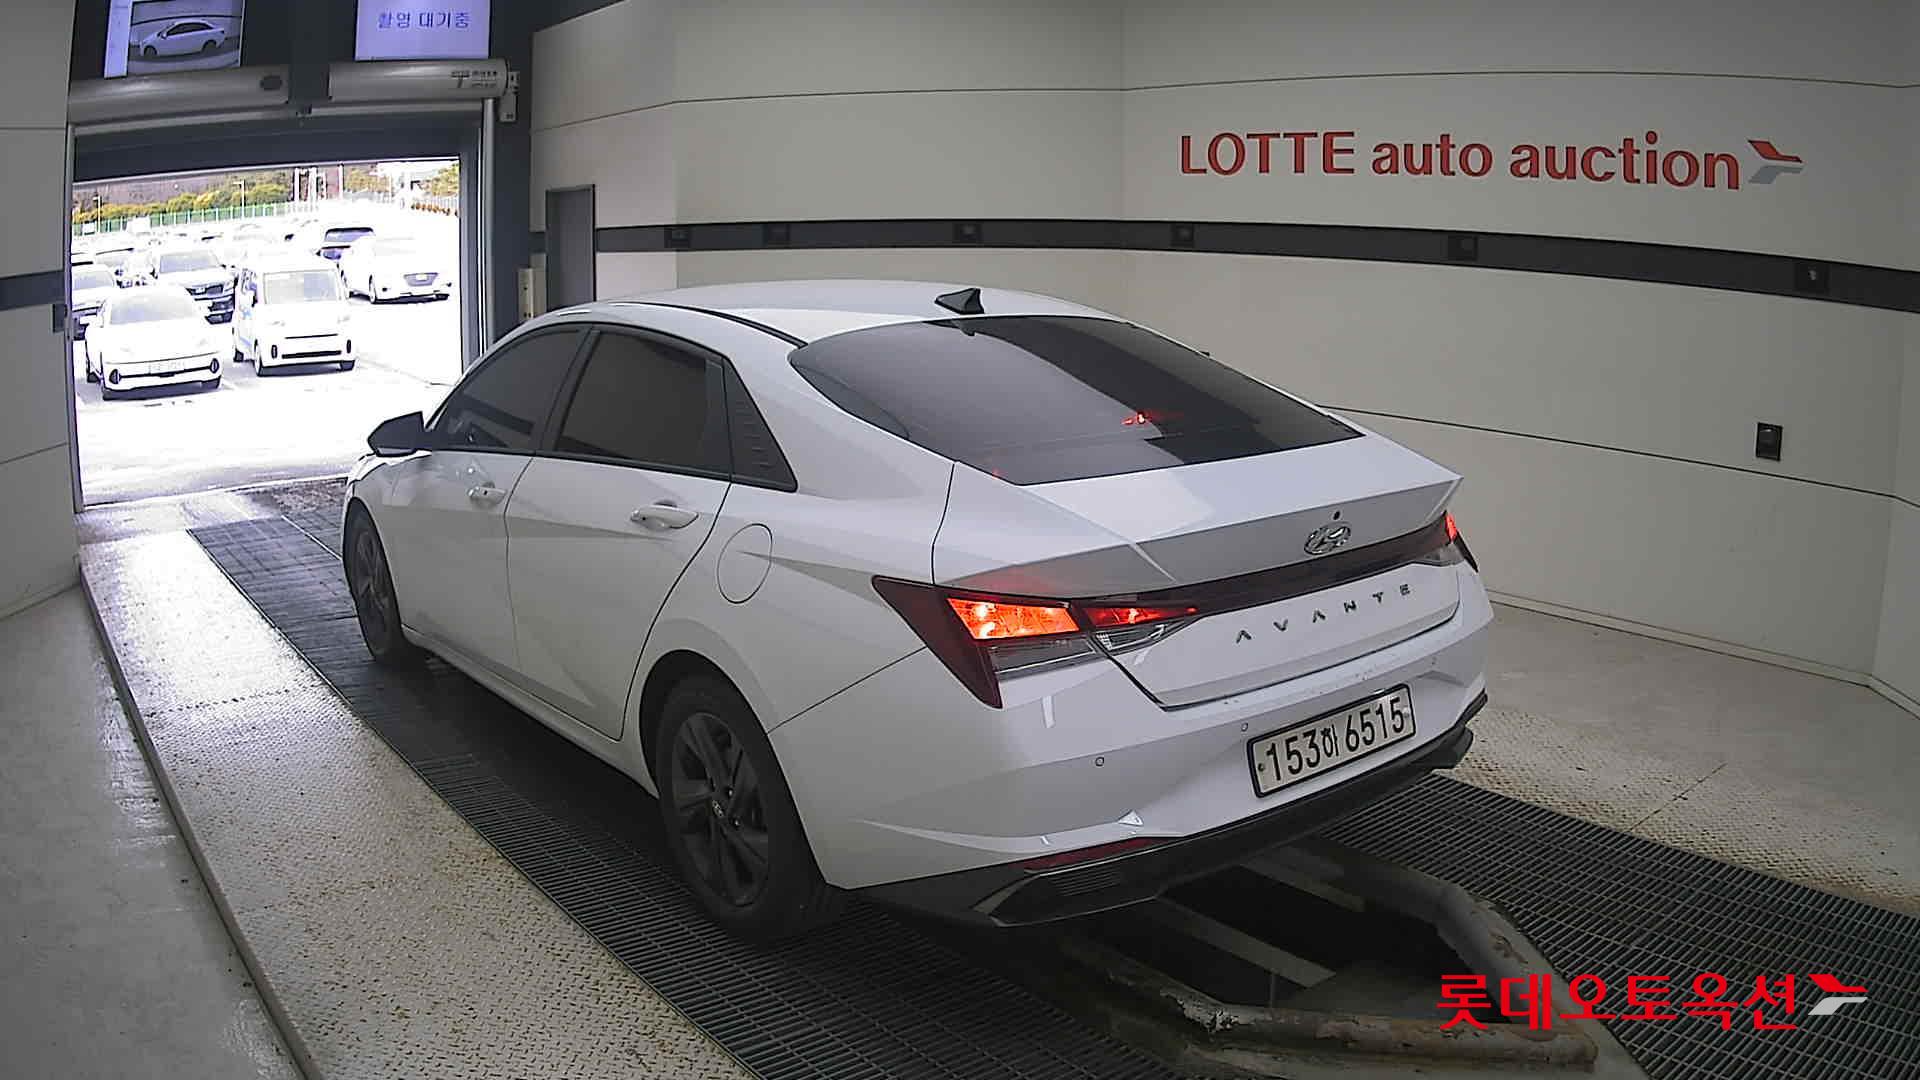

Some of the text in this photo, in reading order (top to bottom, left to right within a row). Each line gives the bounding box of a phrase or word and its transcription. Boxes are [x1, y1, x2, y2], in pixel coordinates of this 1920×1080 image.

[418, 11, 471, 29] 대기중
[1181, 130, 1740, 190] LOTTE auto auction
[1234, 582, 1412, 645] AVANTE
